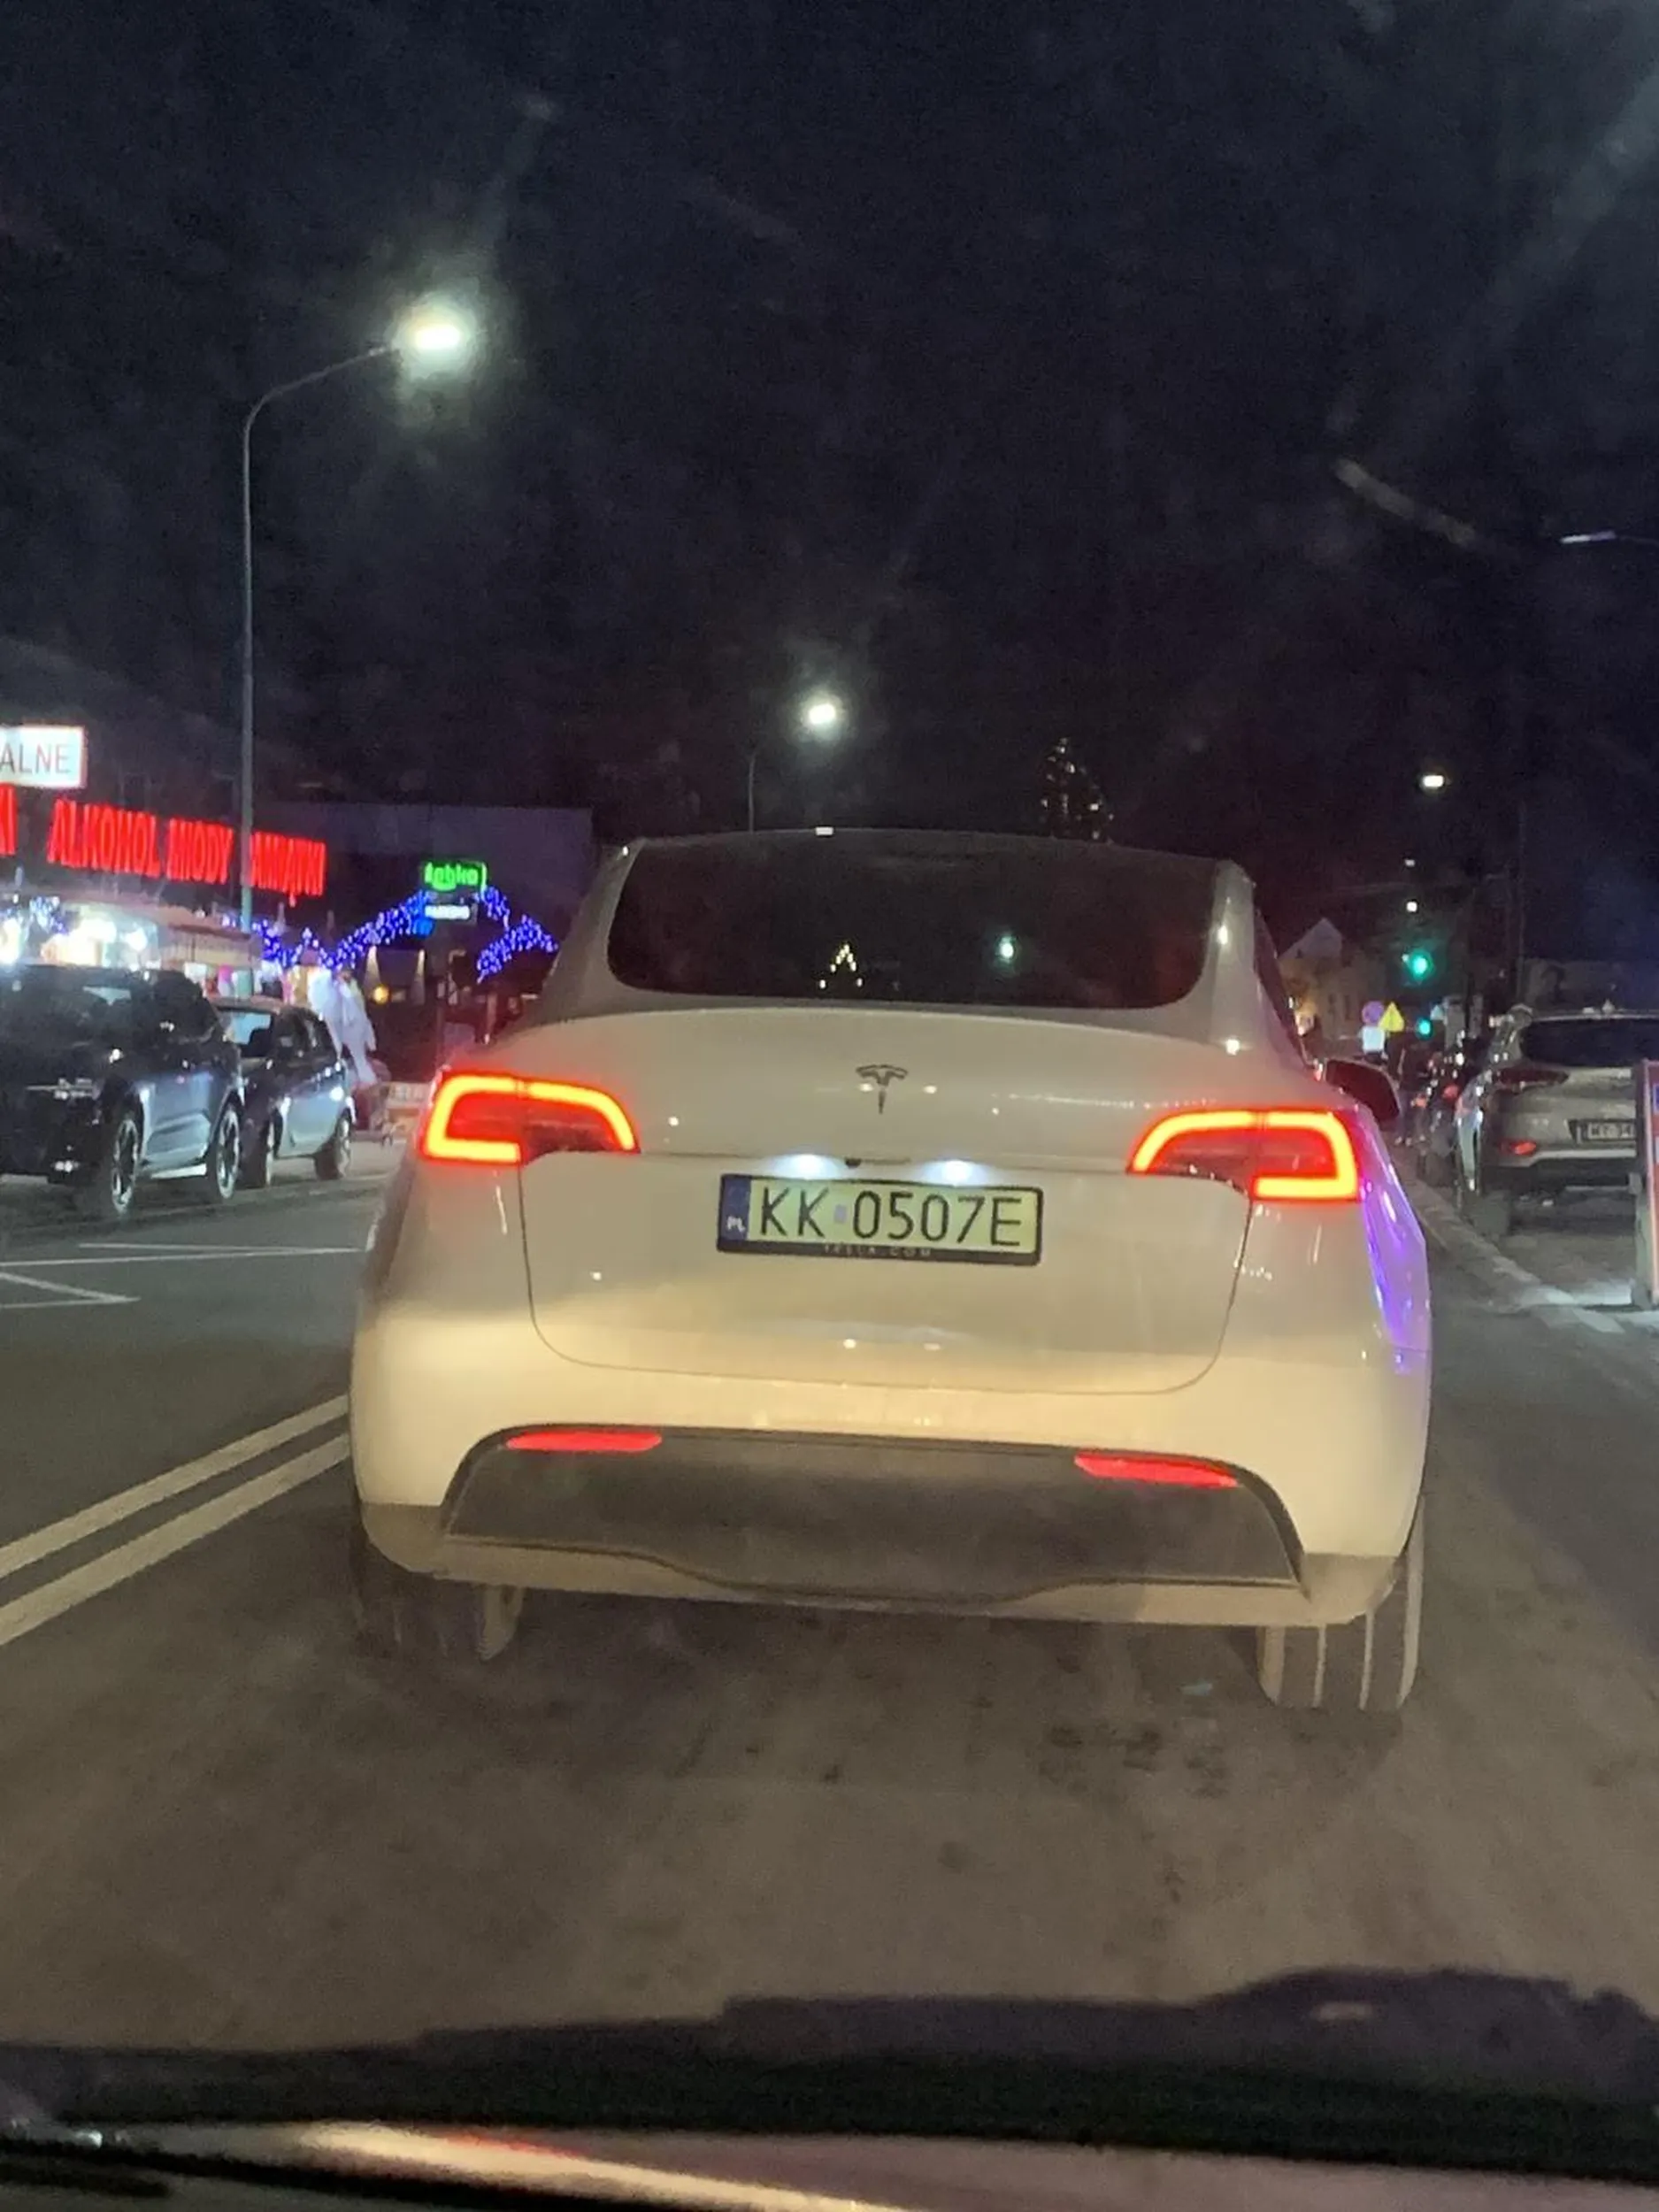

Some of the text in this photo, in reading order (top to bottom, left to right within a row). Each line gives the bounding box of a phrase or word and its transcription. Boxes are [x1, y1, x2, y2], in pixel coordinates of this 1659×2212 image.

[47, 798, 160, 878] ALKOHOL
[760, 1187, 1022, 1247] KK 0507E
